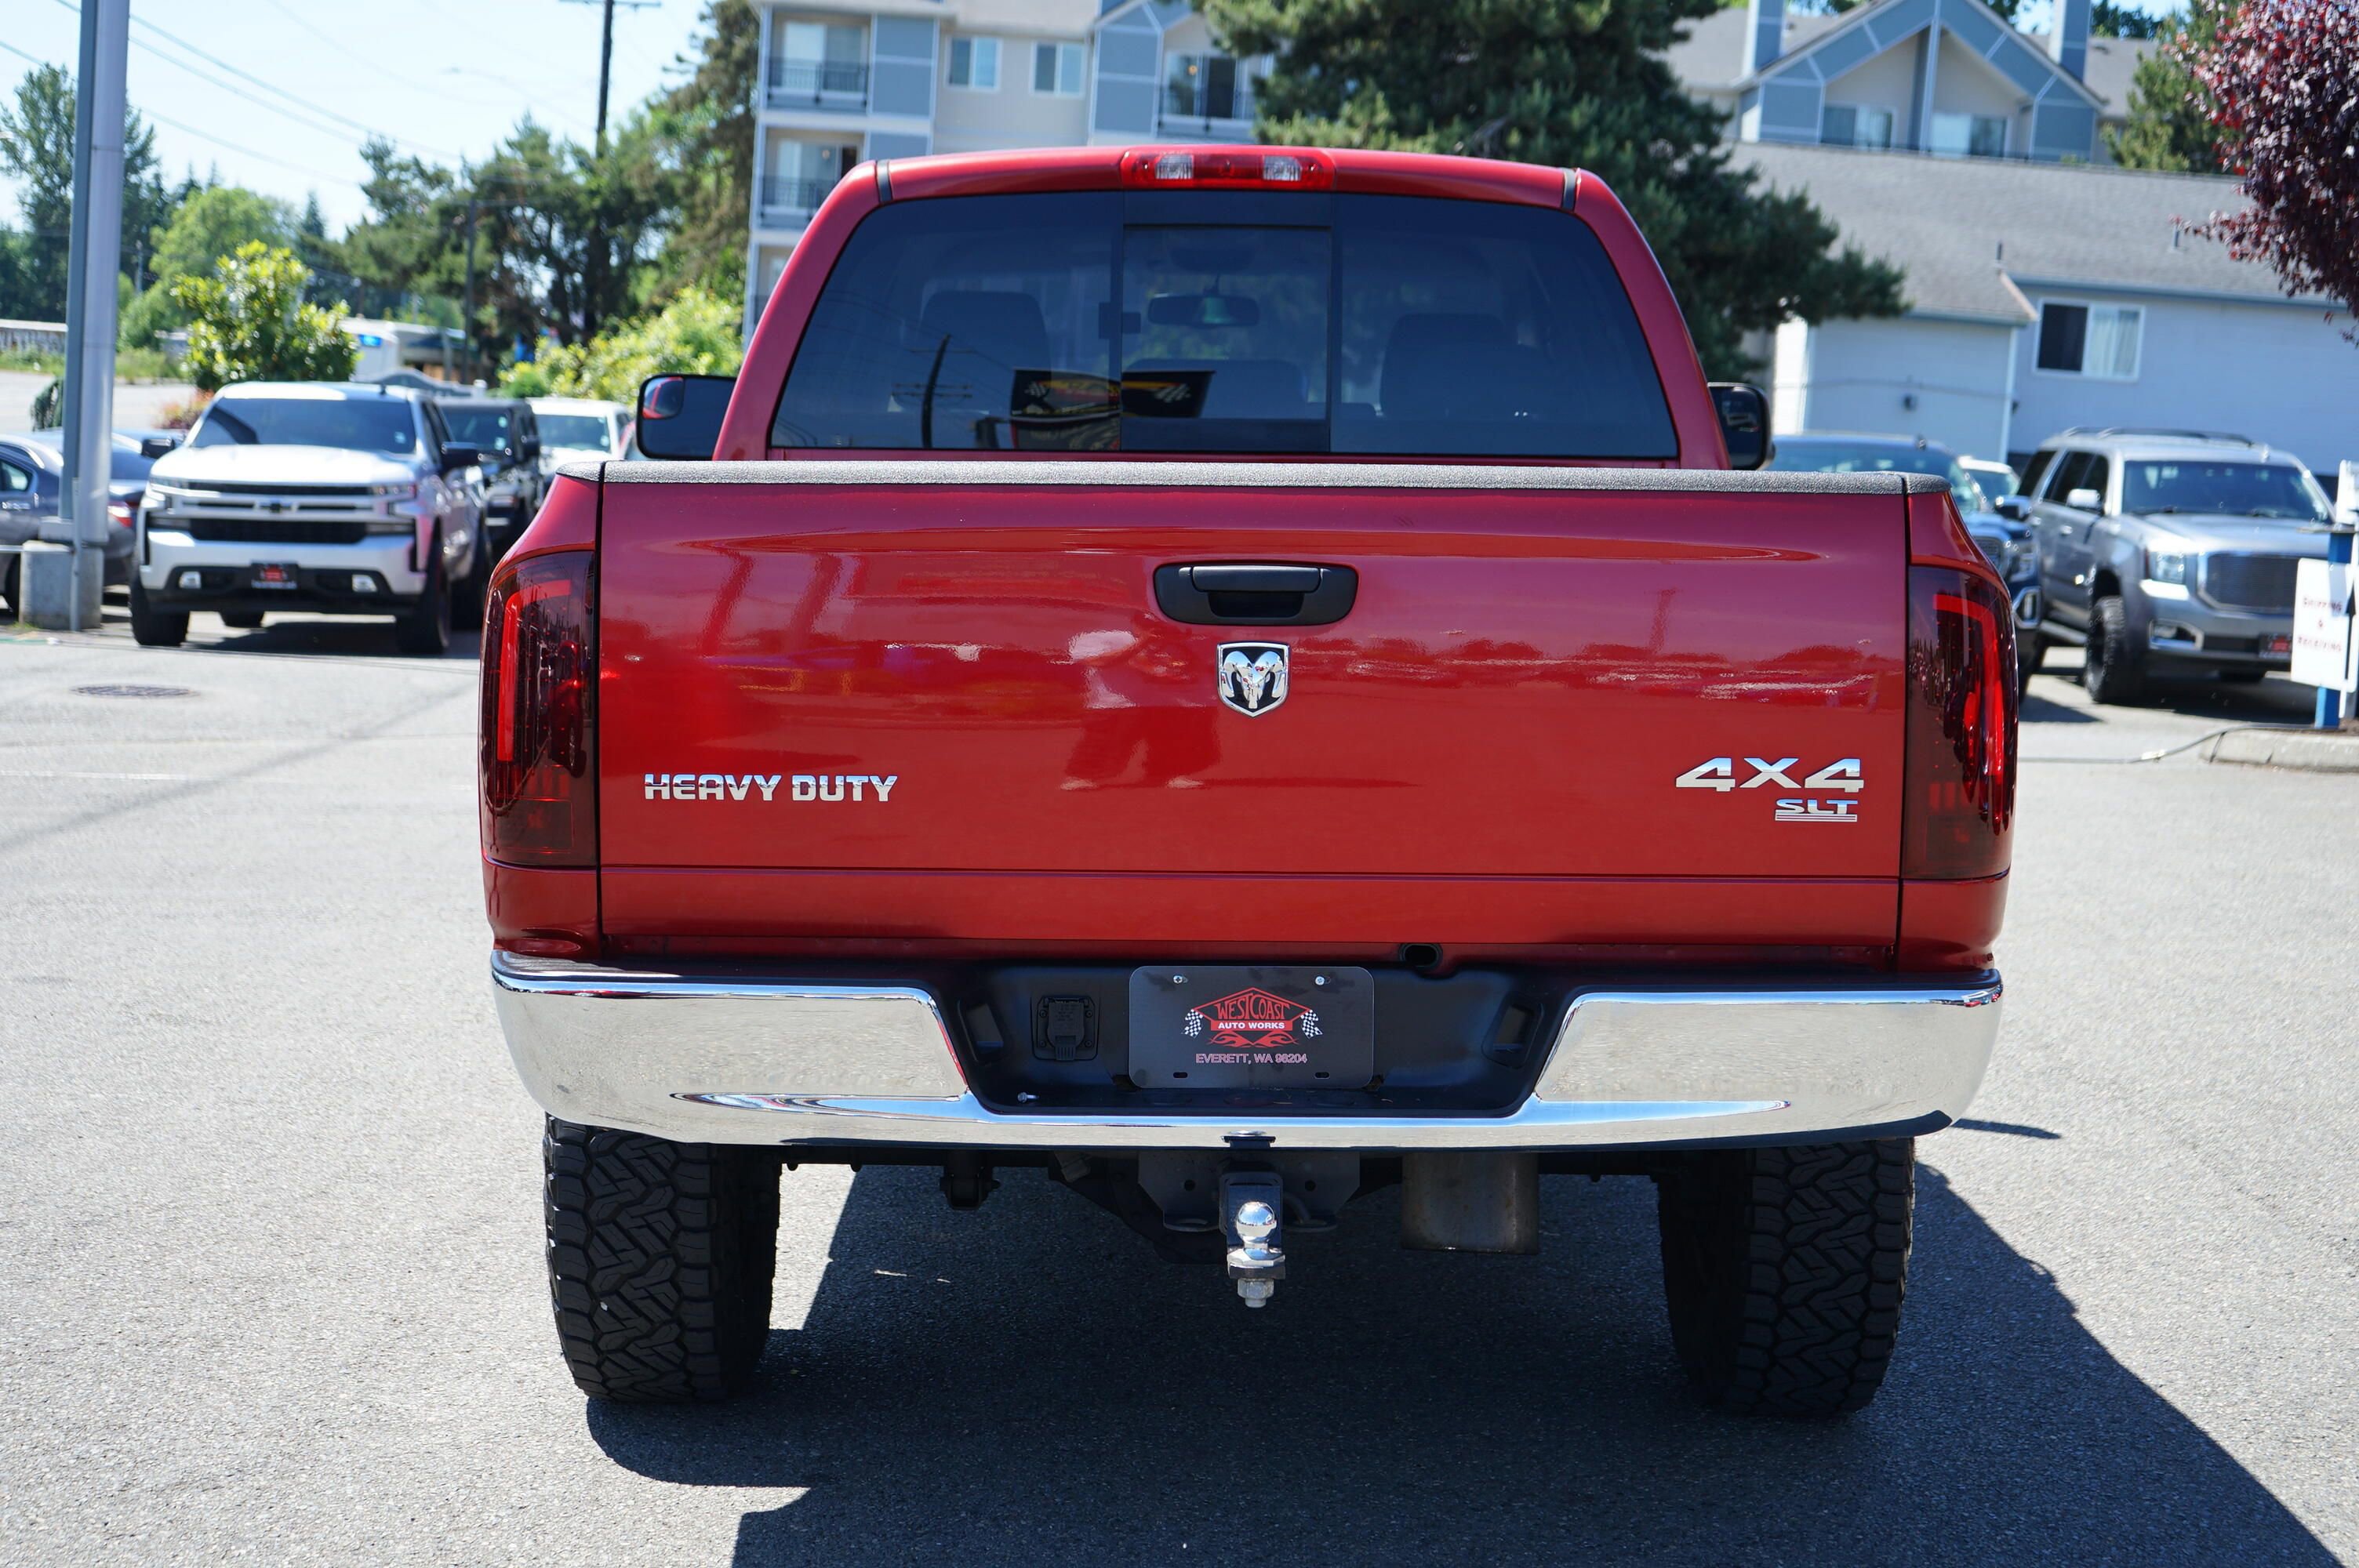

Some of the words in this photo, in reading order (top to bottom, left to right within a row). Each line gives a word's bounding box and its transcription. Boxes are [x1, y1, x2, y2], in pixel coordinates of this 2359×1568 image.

[645, 774, 782, 800] HEAVY
[792, 775, 898, 801] DUTY
[1775, 799, 1859, 815] SLT
[1195, 1053, 1252, 1065] EVERETT,
[1254, 1053, 1274, 1064] WA
